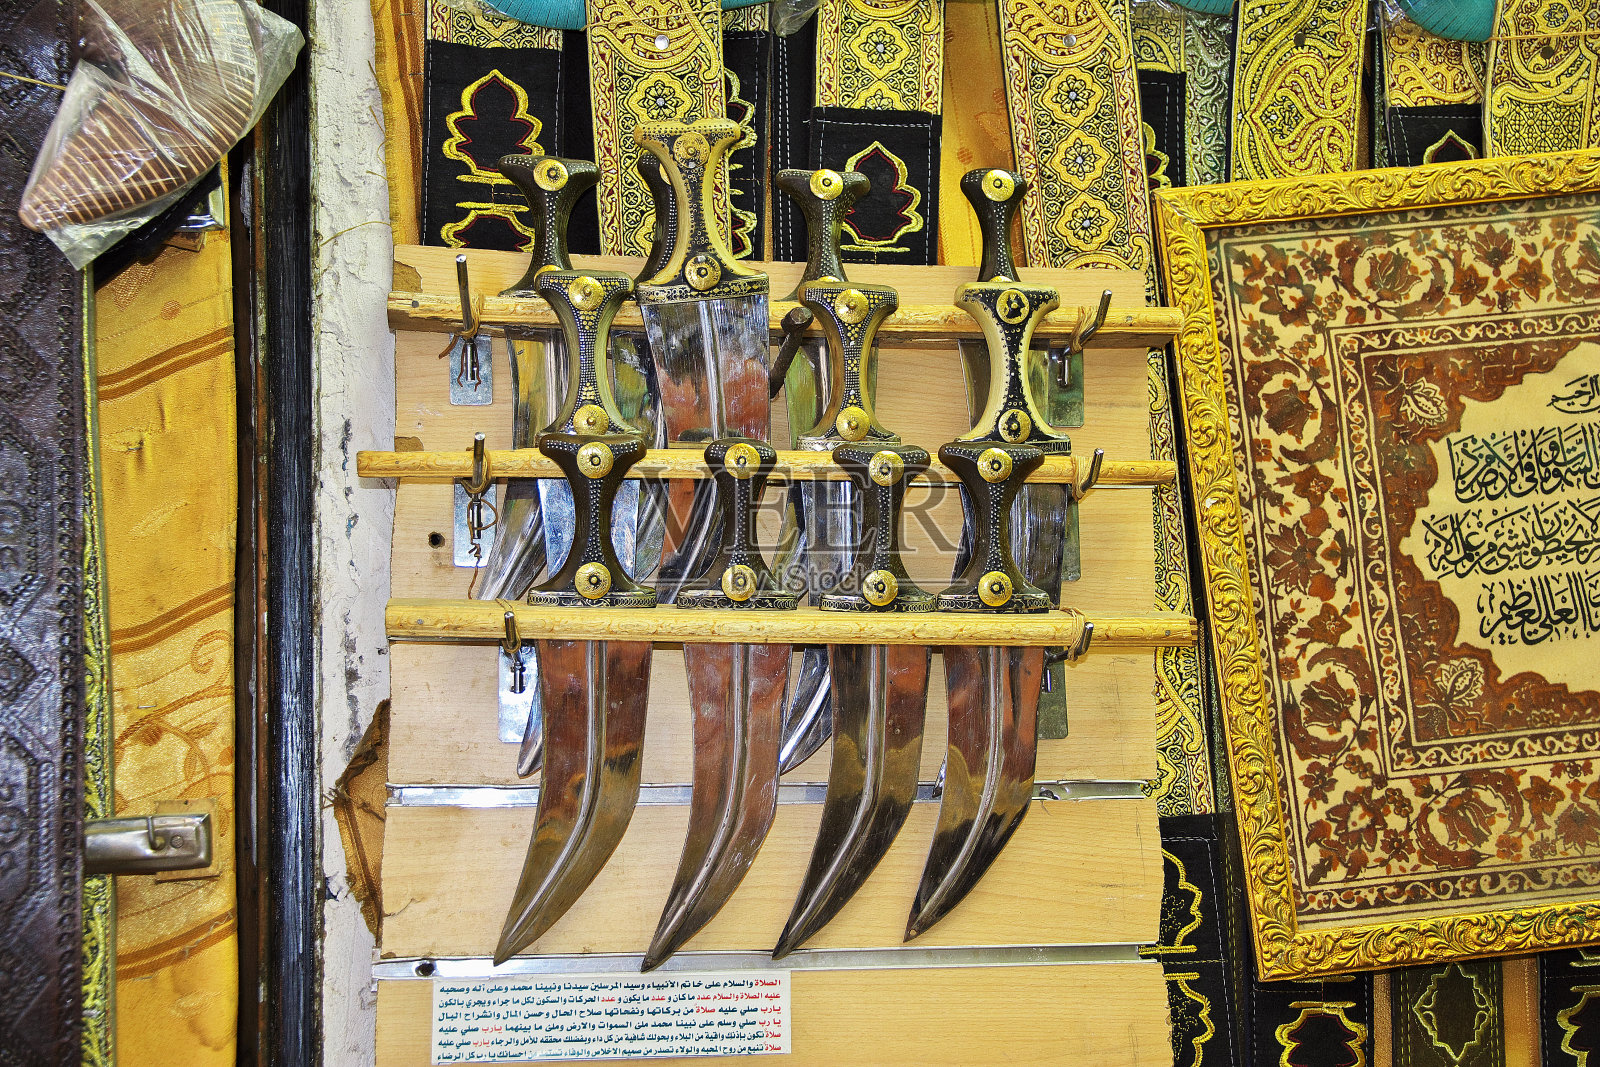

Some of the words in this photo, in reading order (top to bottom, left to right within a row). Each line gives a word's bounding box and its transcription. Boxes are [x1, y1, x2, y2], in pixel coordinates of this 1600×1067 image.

[472, 984, 485, 992] آله
[535, 982, 562, 993] ونبينا
[563, 982, 589, 992] سيدنا
[590, 981, 622, 991] المرسلين
[624, 982, 645, 990] وسيد
[647, 979, 679, 990] الأنبياء
[704, 981, 721, 989] على
[723, 979, 754, 988] والسلام
[439, 986, 470, 995] وصحبه
[486, 984, 508, 993] وعلى
[536, 996, 567, 1005] والسكون
[567, 995, 600, 1004] الحركات
[622, 994, 641, 1004] يكون
[713, 993, 739, 1001] والسلام
[764, 992, 781, 1000] عليه
[438, 998, 465, 1008] بالكون
[521, 996, 535, 1006] لكل
[464, 1010, 501, 1020] وانشراح
[502, 1010, 522, 1020] المال
[552, 1009, 577, 1018] الحال
[579, 1008, 602, 1018] صلاح
[604, 1006, 645, 1017] ونفحاتها
[647, 1006, 681, 1016] بركاتها
[683, 1007, 694, 1015] من
[718, 1006, 737, 1015] عليه
[740, 1005, 758, 1016] صلي
[438, 1012, 462, 1021] البال
[598, 1021, 632, 1030] السموات
[675, 1019, 697, 1029] نبينا
[699, 1020, 715, 1028] على
[717, 1019, 737, 1028] وسلم
[739, 1019, 757, 1029] صلي
[438, 1026, 458, 1035] عليه
[461, 1025, 479, 1035] صلي
[505, 1024, 531, 1033] بينهما
[625, 1033, 645, 1043] شافية
[675, 1033, 694, 1042] البلاء
[705, 1031, 724, 1041] واقية
[747, 1030, 764, 1040] تكون
[438, 1039, 454, 1049] عليه
[455, 1039, 471, 1049] صلي
[491, 1037, 519, 1046] والرجاء
[622, 1048, 642, 1056] صميم
[642, 1047, 652, 1055] من
[654, 1046, 674, 1055] تصدر
[675, 1046, 699, 1054] والولاء
[722, 1046, 736, 1054] روح
[747, 1044, 764, 1054] تنبع
